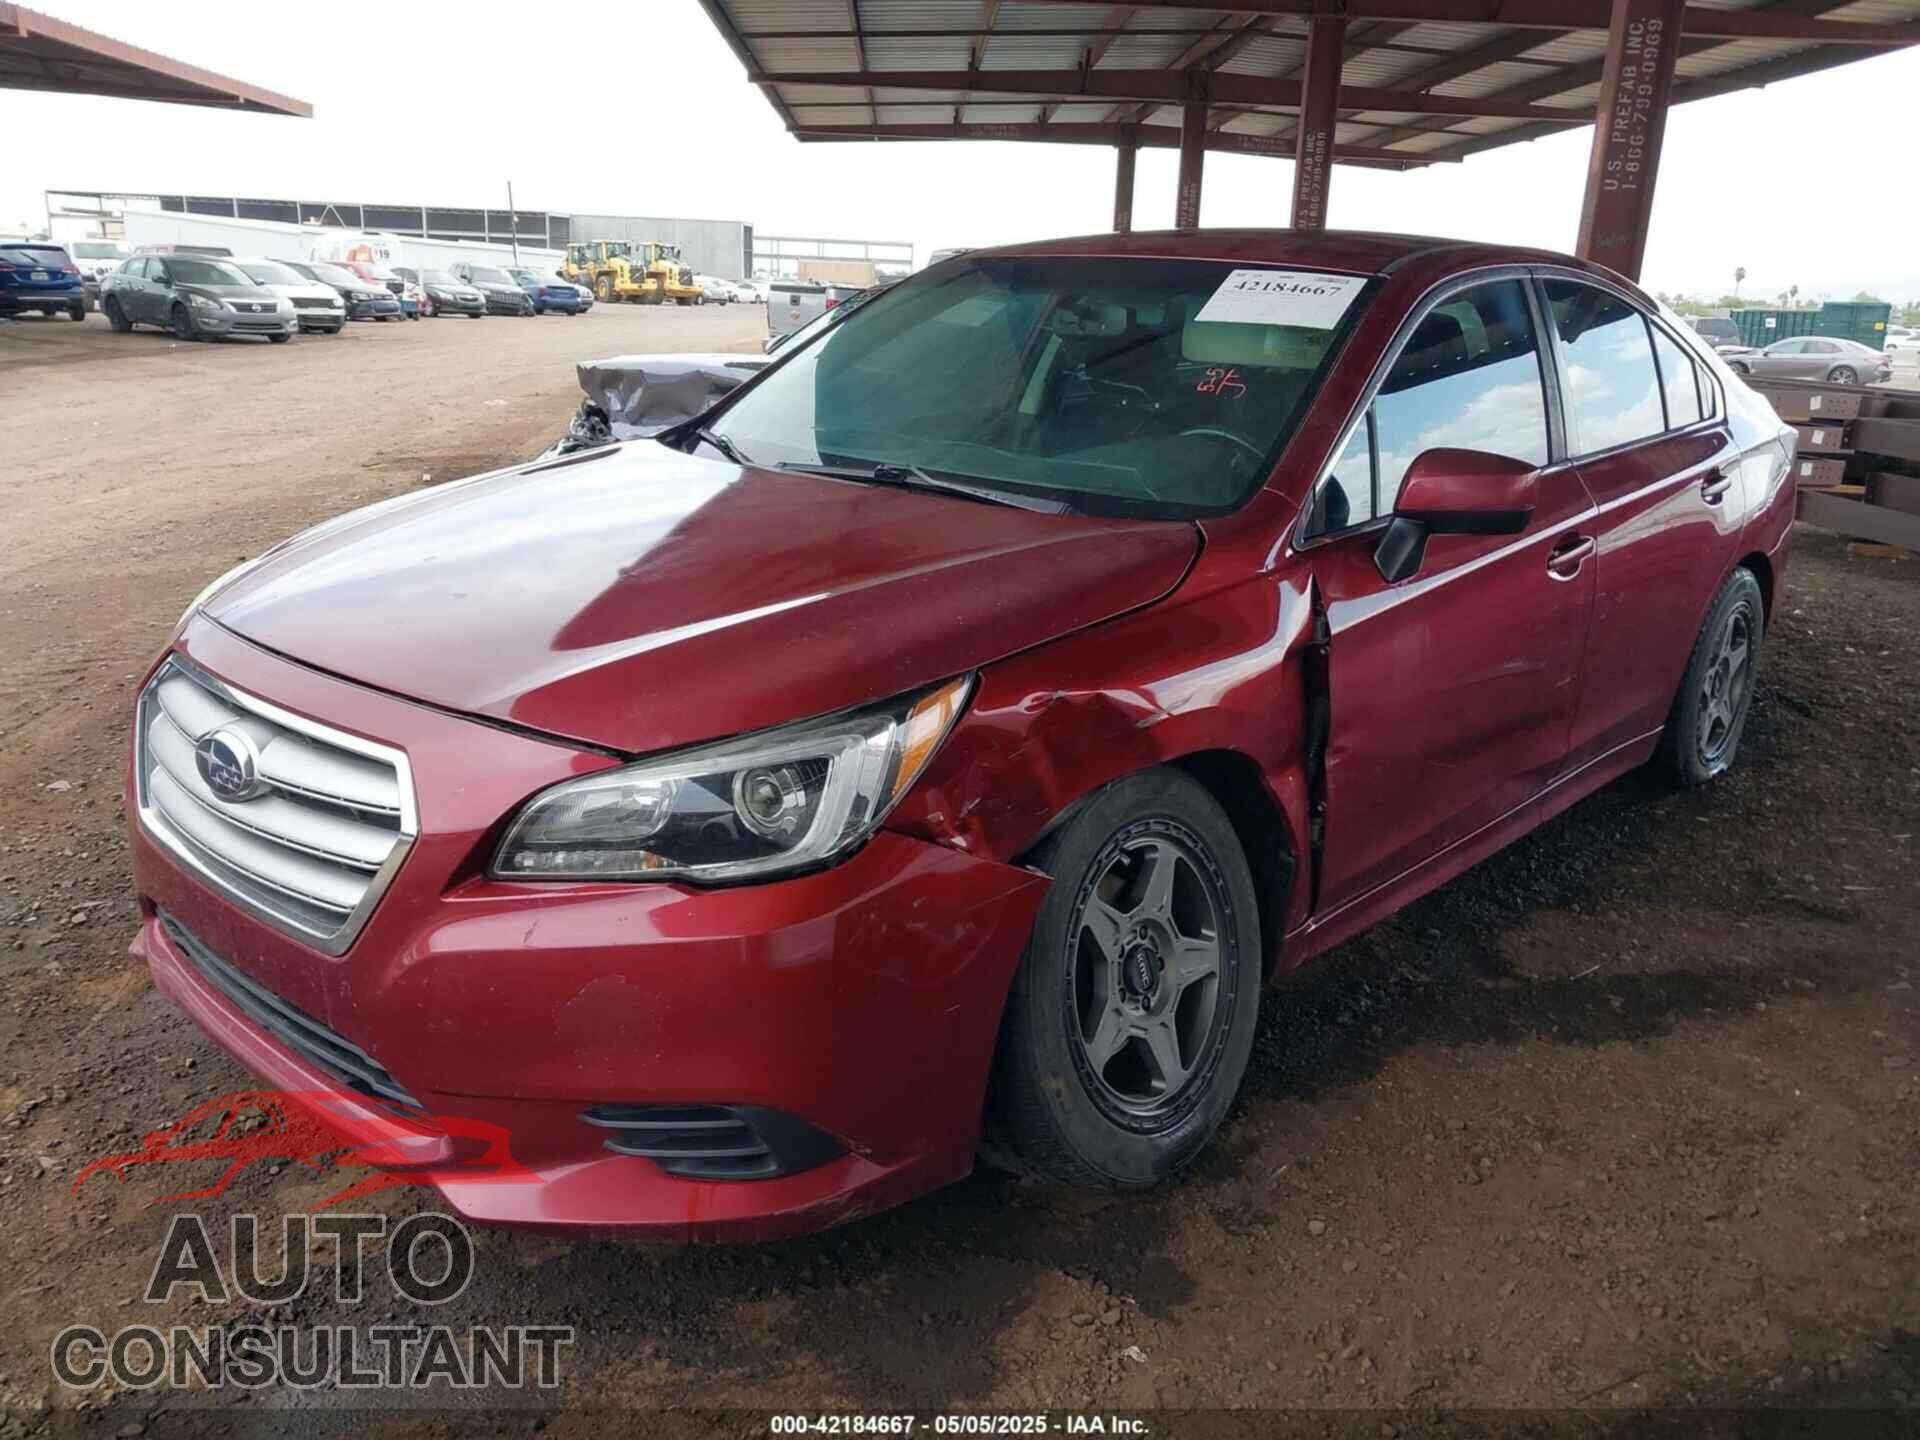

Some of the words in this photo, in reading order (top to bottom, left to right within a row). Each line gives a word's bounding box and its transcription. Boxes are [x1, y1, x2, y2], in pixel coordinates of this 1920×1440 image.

[1626, 17, 1646, 54] INC.
[1612, 66, 1638, 142] PREFAB
[1604, 153, 1624, 190] U.S.
[1234, 281, 1341, 297] 42184667
